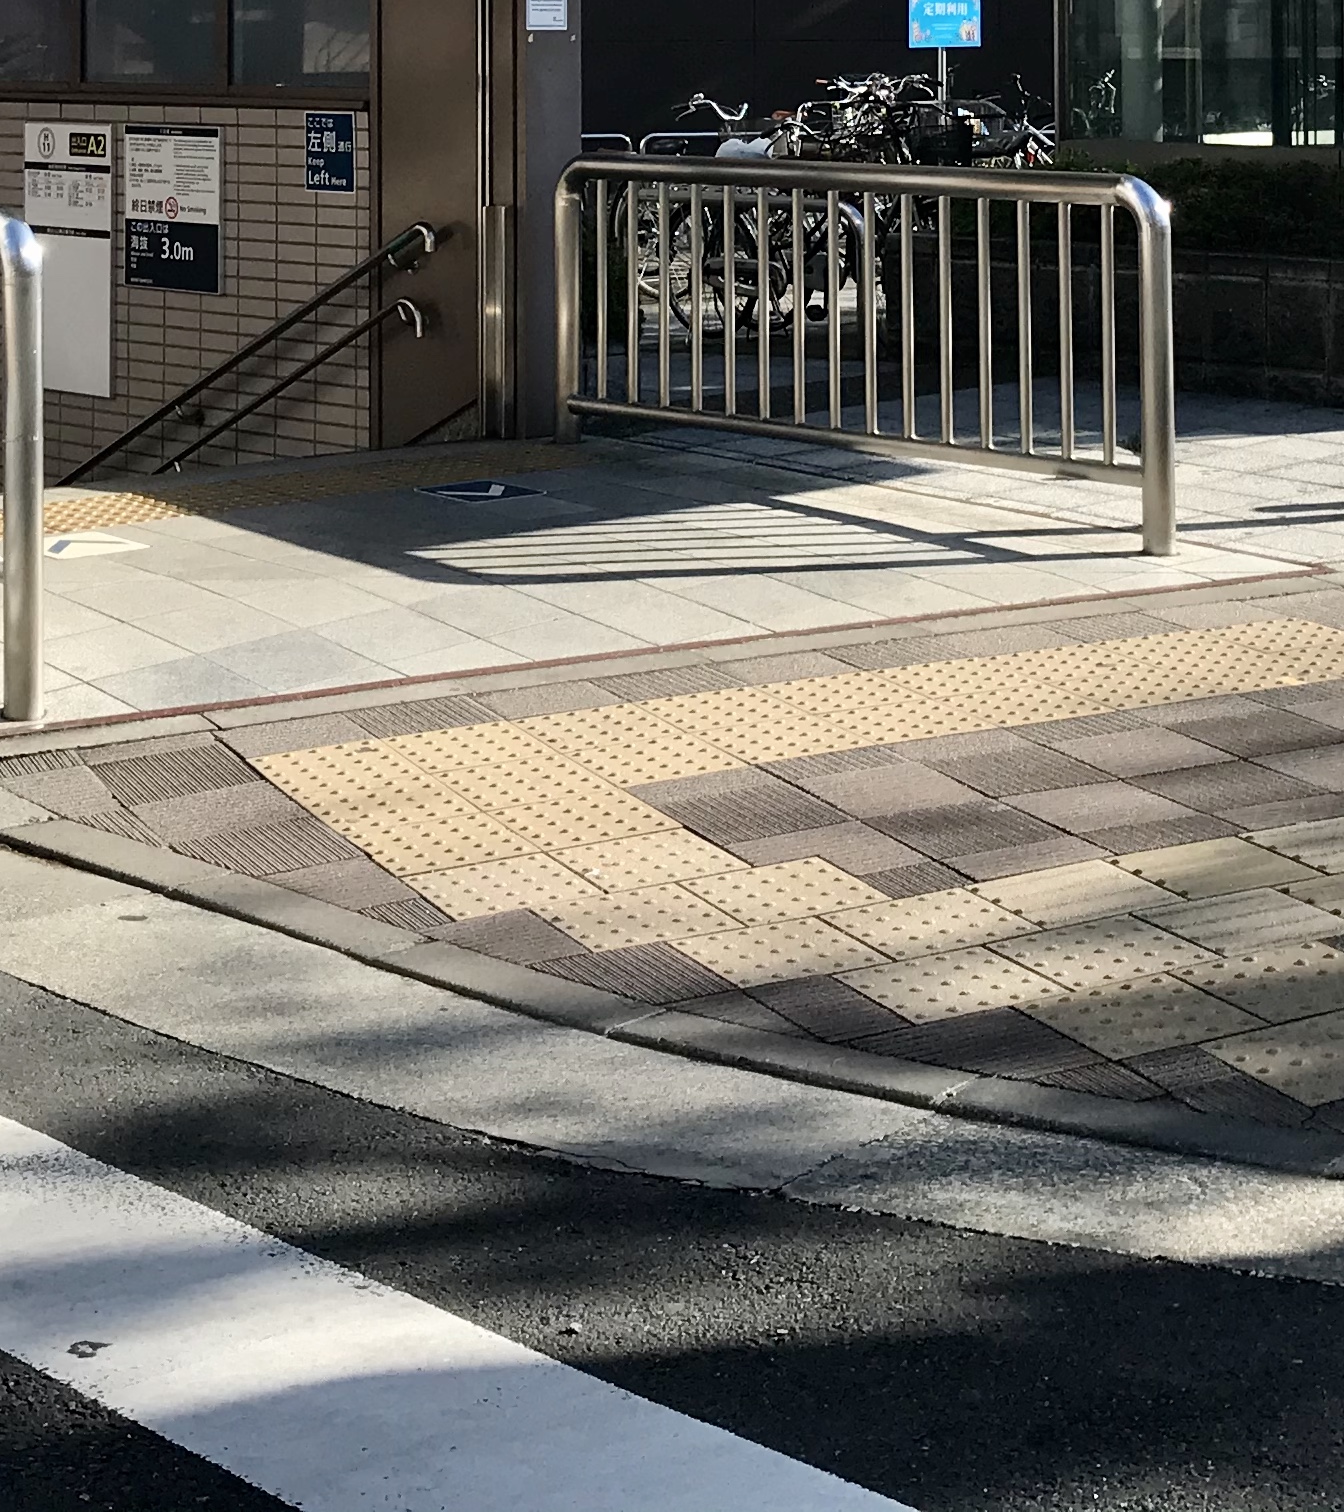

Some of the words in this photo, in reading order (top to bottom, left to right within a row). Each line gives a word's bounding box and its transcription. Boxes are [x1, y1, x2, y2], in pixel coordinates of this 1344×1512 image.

[923, 1, 968, 17] 定期利用
[87, 135, 105, 155] A2
[307, 156, 325, 168] Keep
[308, 169, 330, 186] Left
[160, 237, 194, 261] 3.0m
